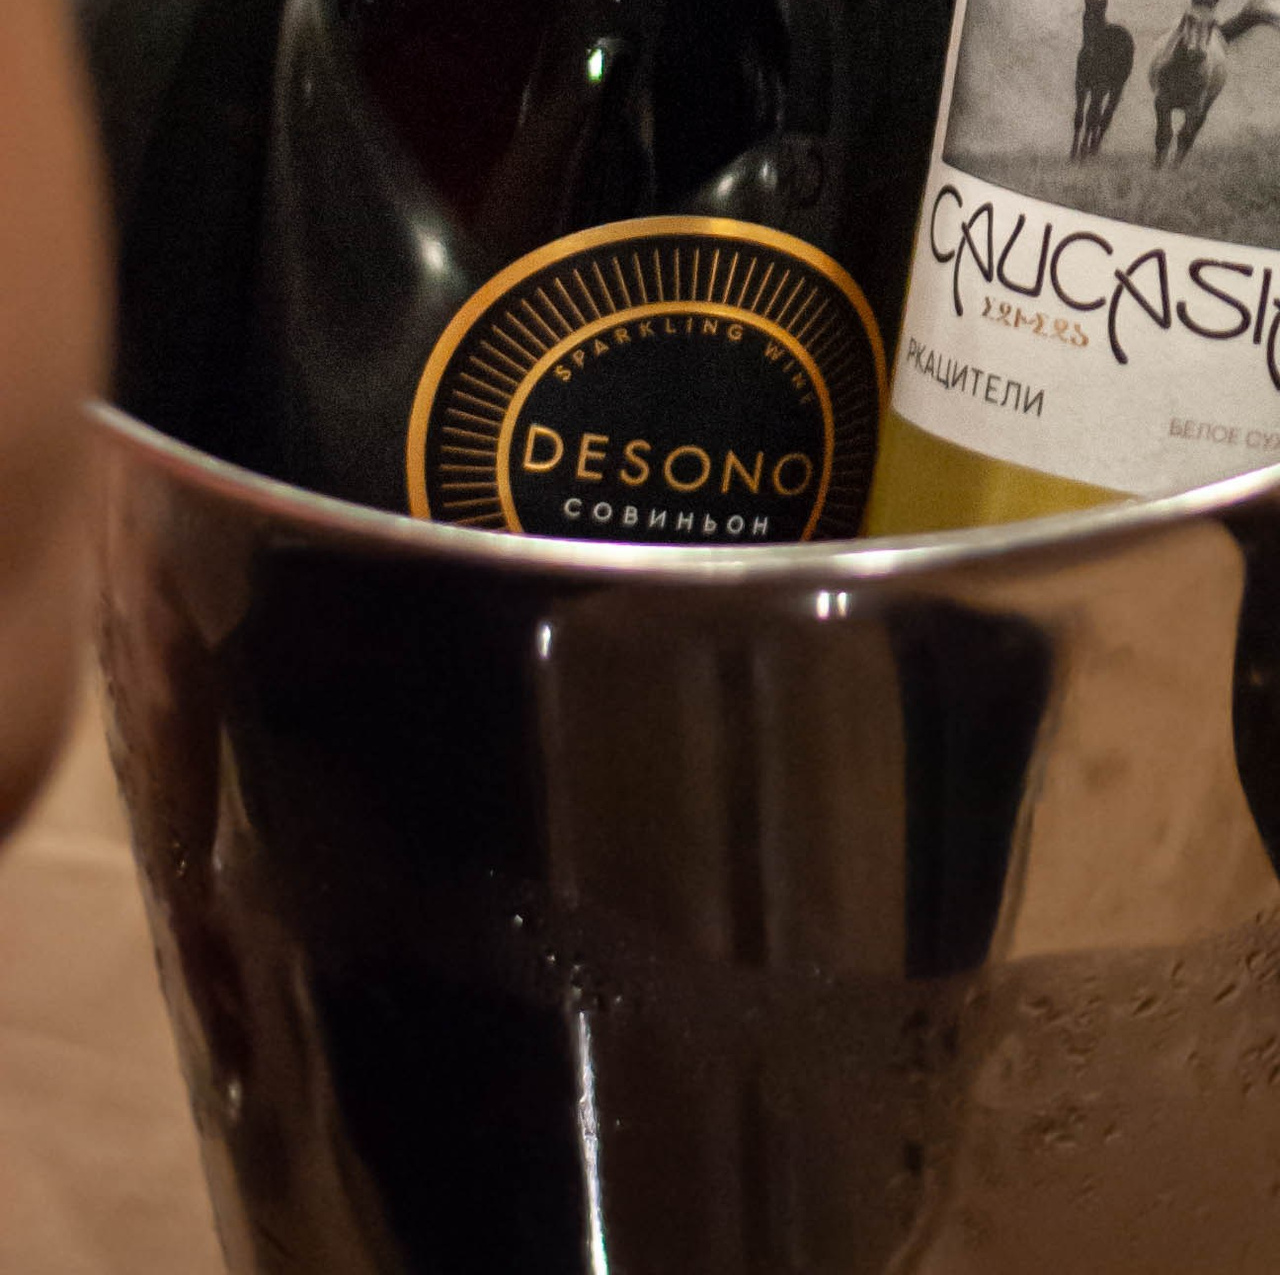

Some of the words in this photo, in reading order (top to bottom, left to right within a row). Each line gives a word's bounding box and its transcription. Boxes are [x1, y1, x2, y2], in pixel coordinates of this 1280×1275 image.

[554, 317, 745, 383] SPARKLING
[906, 336, 1045, 418] РКАЦИТЕЛИ
[522, 423, 813, 495] DESONO
[563, 497, 769, 536] СОВИНЬОН
